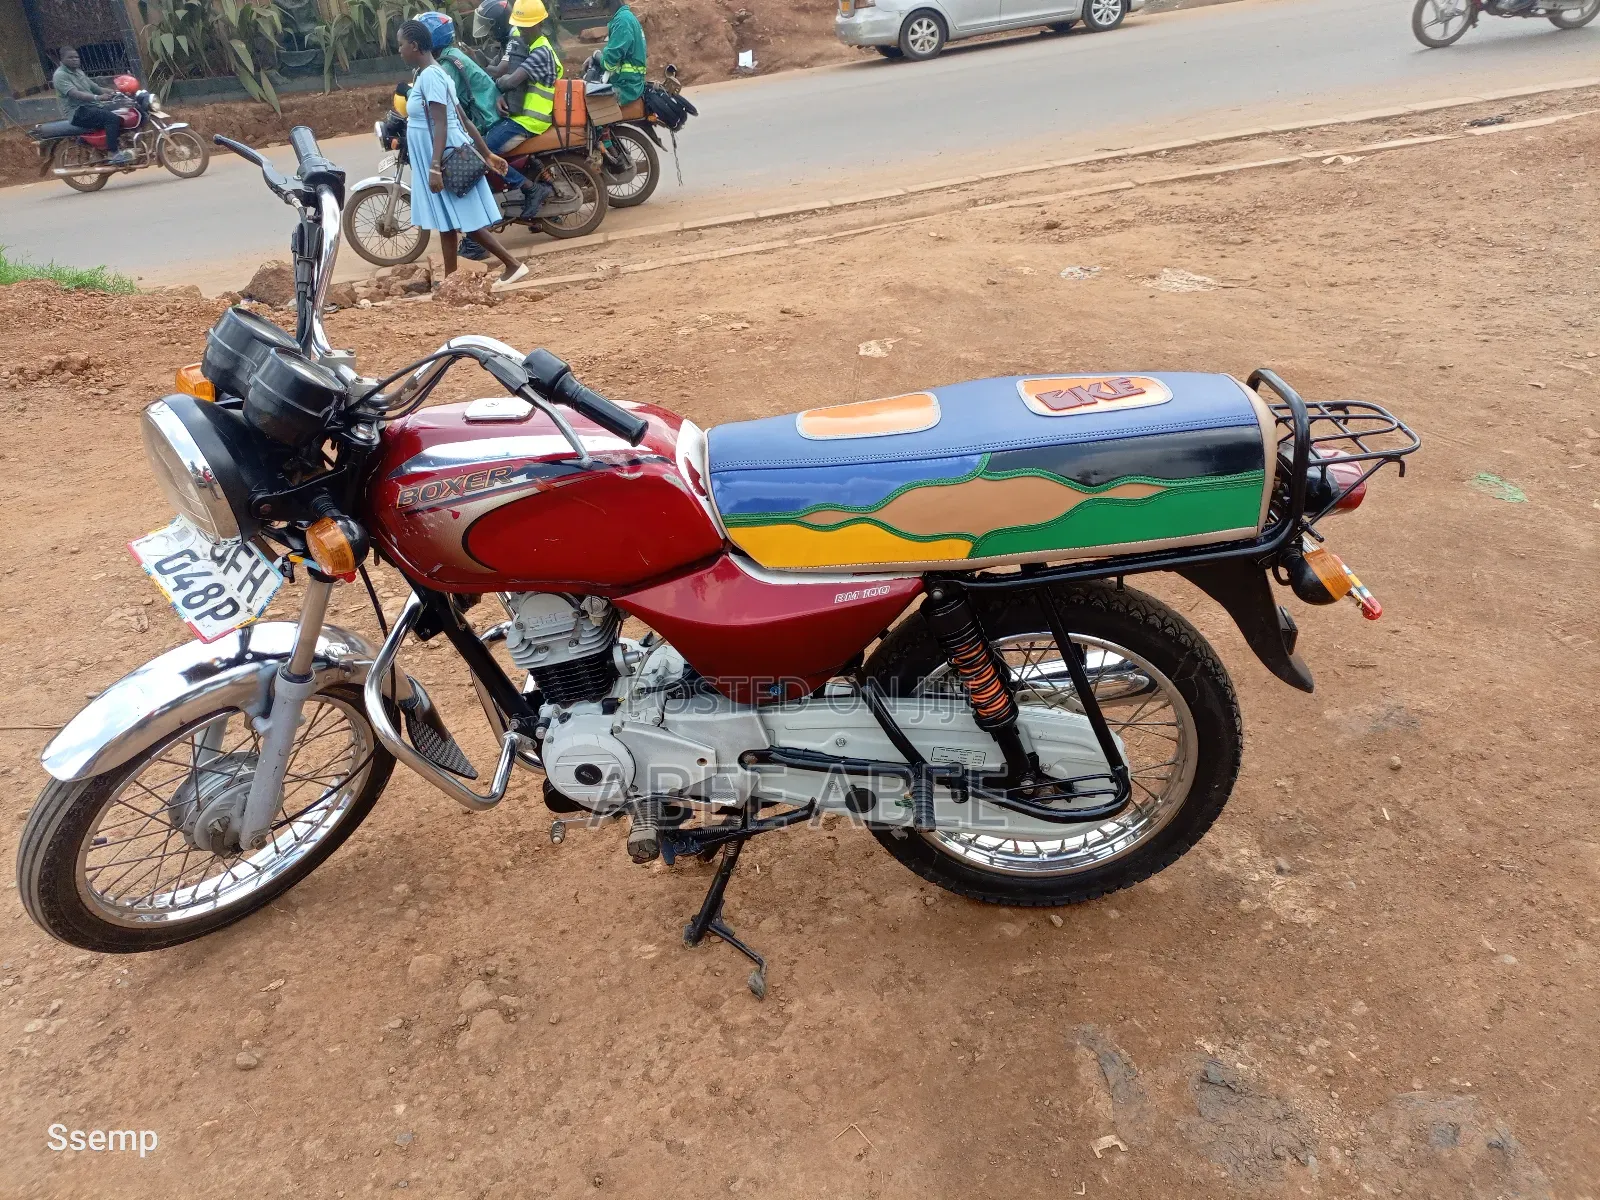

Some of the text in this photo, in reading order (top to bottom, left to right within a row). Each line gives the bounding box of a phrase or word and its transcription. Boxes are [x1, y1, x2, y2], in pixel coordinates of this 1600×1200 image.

[396, 465, 513, 509] BOXER
[834, 585, 890, 603] BM 100
